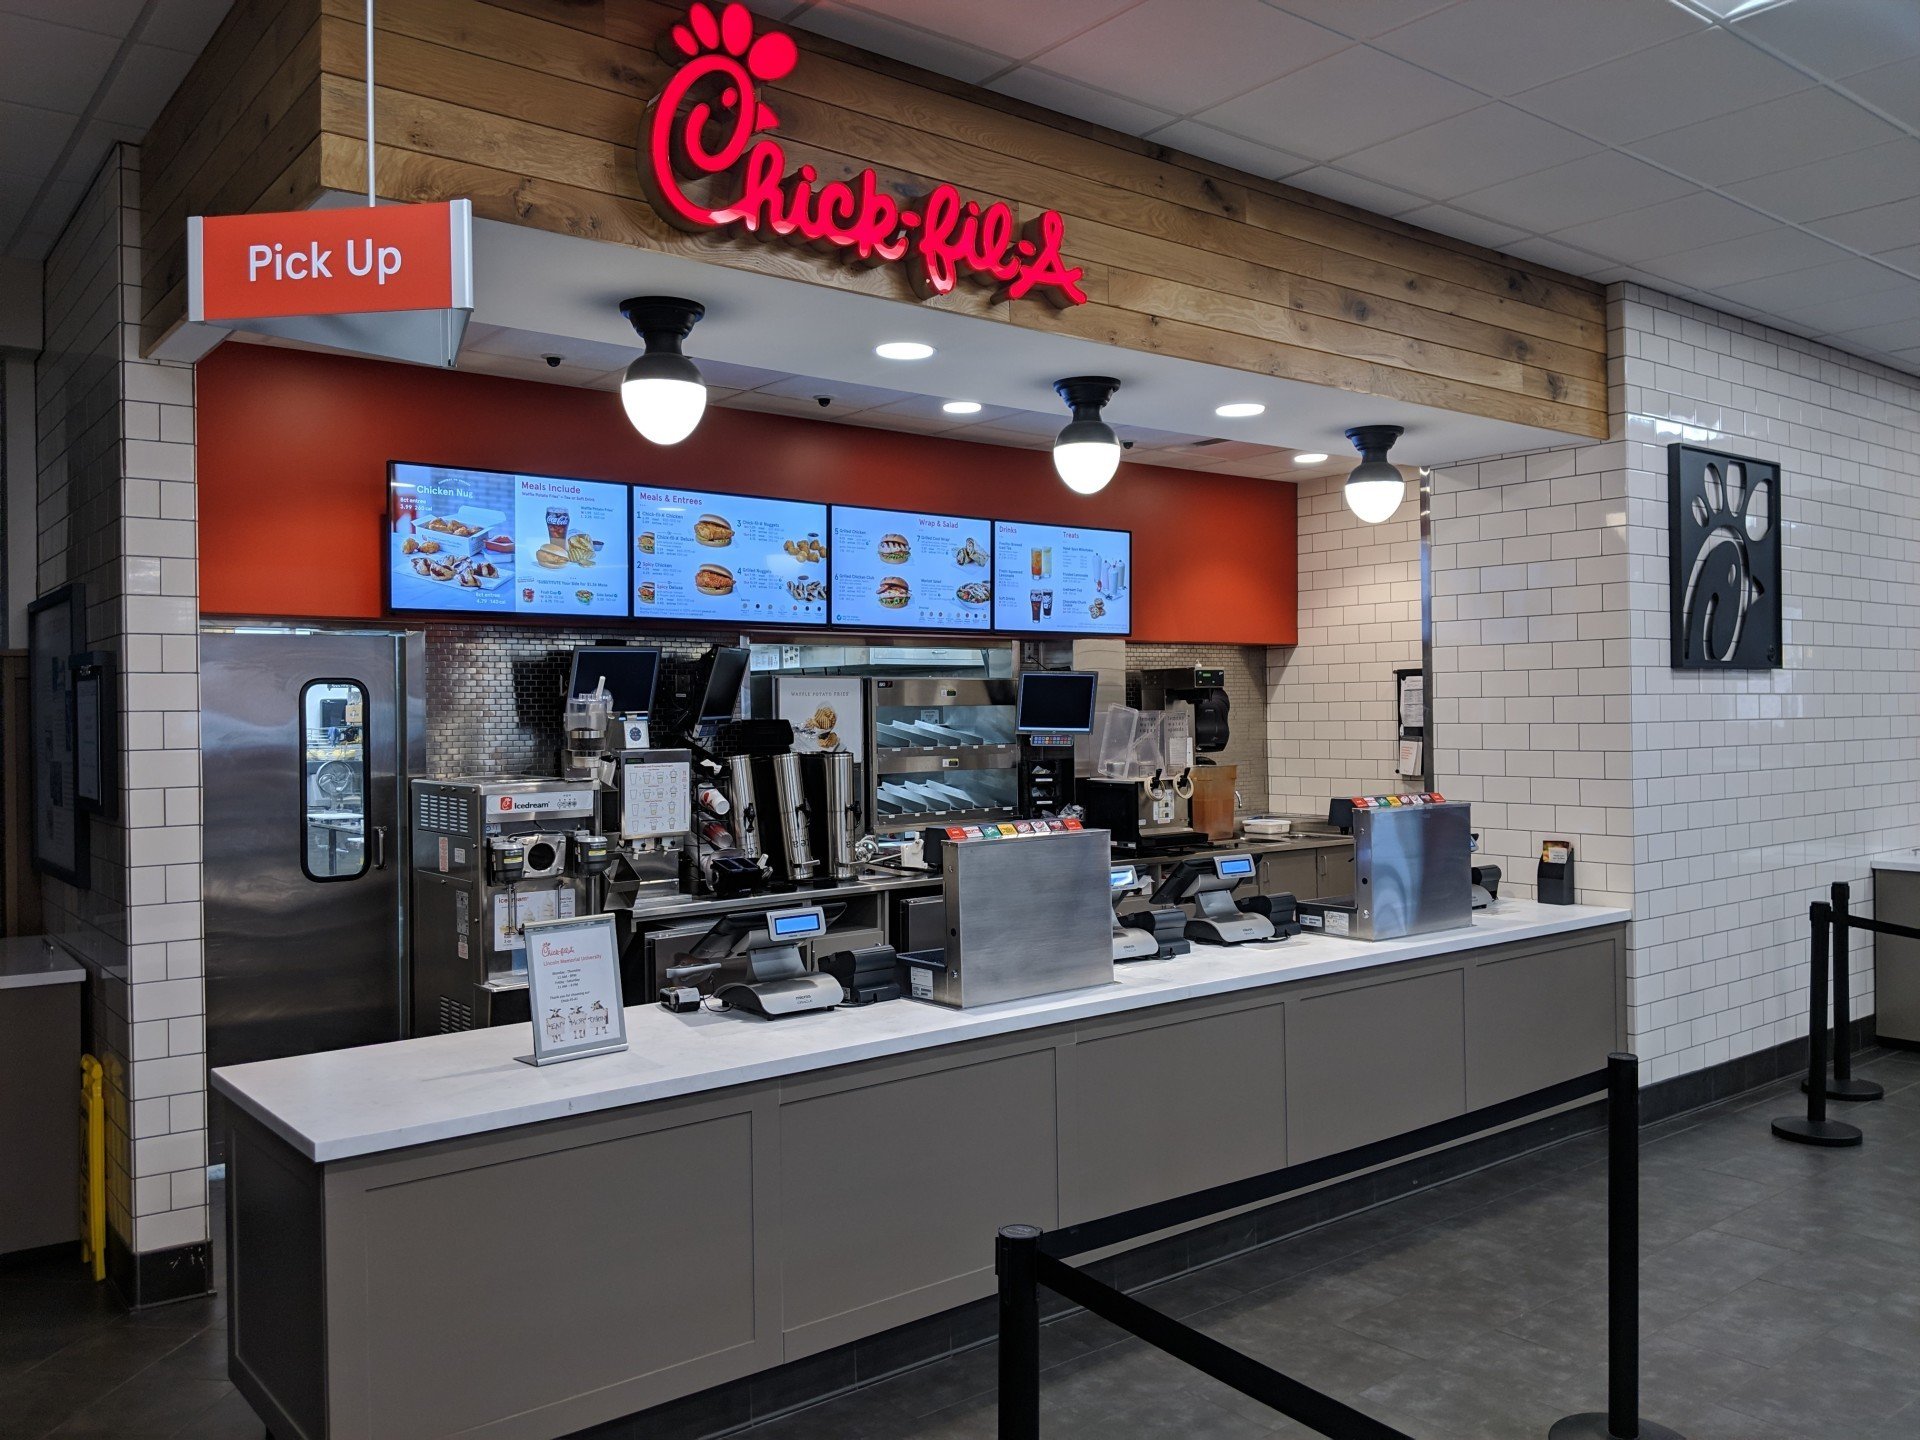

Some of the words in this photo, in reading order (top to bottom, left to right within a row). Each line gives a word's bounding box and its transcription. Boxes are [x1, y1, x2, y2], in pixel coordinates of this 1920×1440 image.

[650, 3, 1087, 304] Chick-fil-A
[250, 241, 332, 282] Pick
[347, 238, 402, 284] Up
[416, 485, 454, 496] Chicken
[521, 481, 546, 490] Meals
[548, 484, 580, 494] Include
[640, 492, 662, 502] Meals
[672, 496, 702, 505] Entrees
[919, 519, 936, 528] Wrap
[942, 520, 958, 528] Salad
[999, 526, 1017, 534] Drinks
